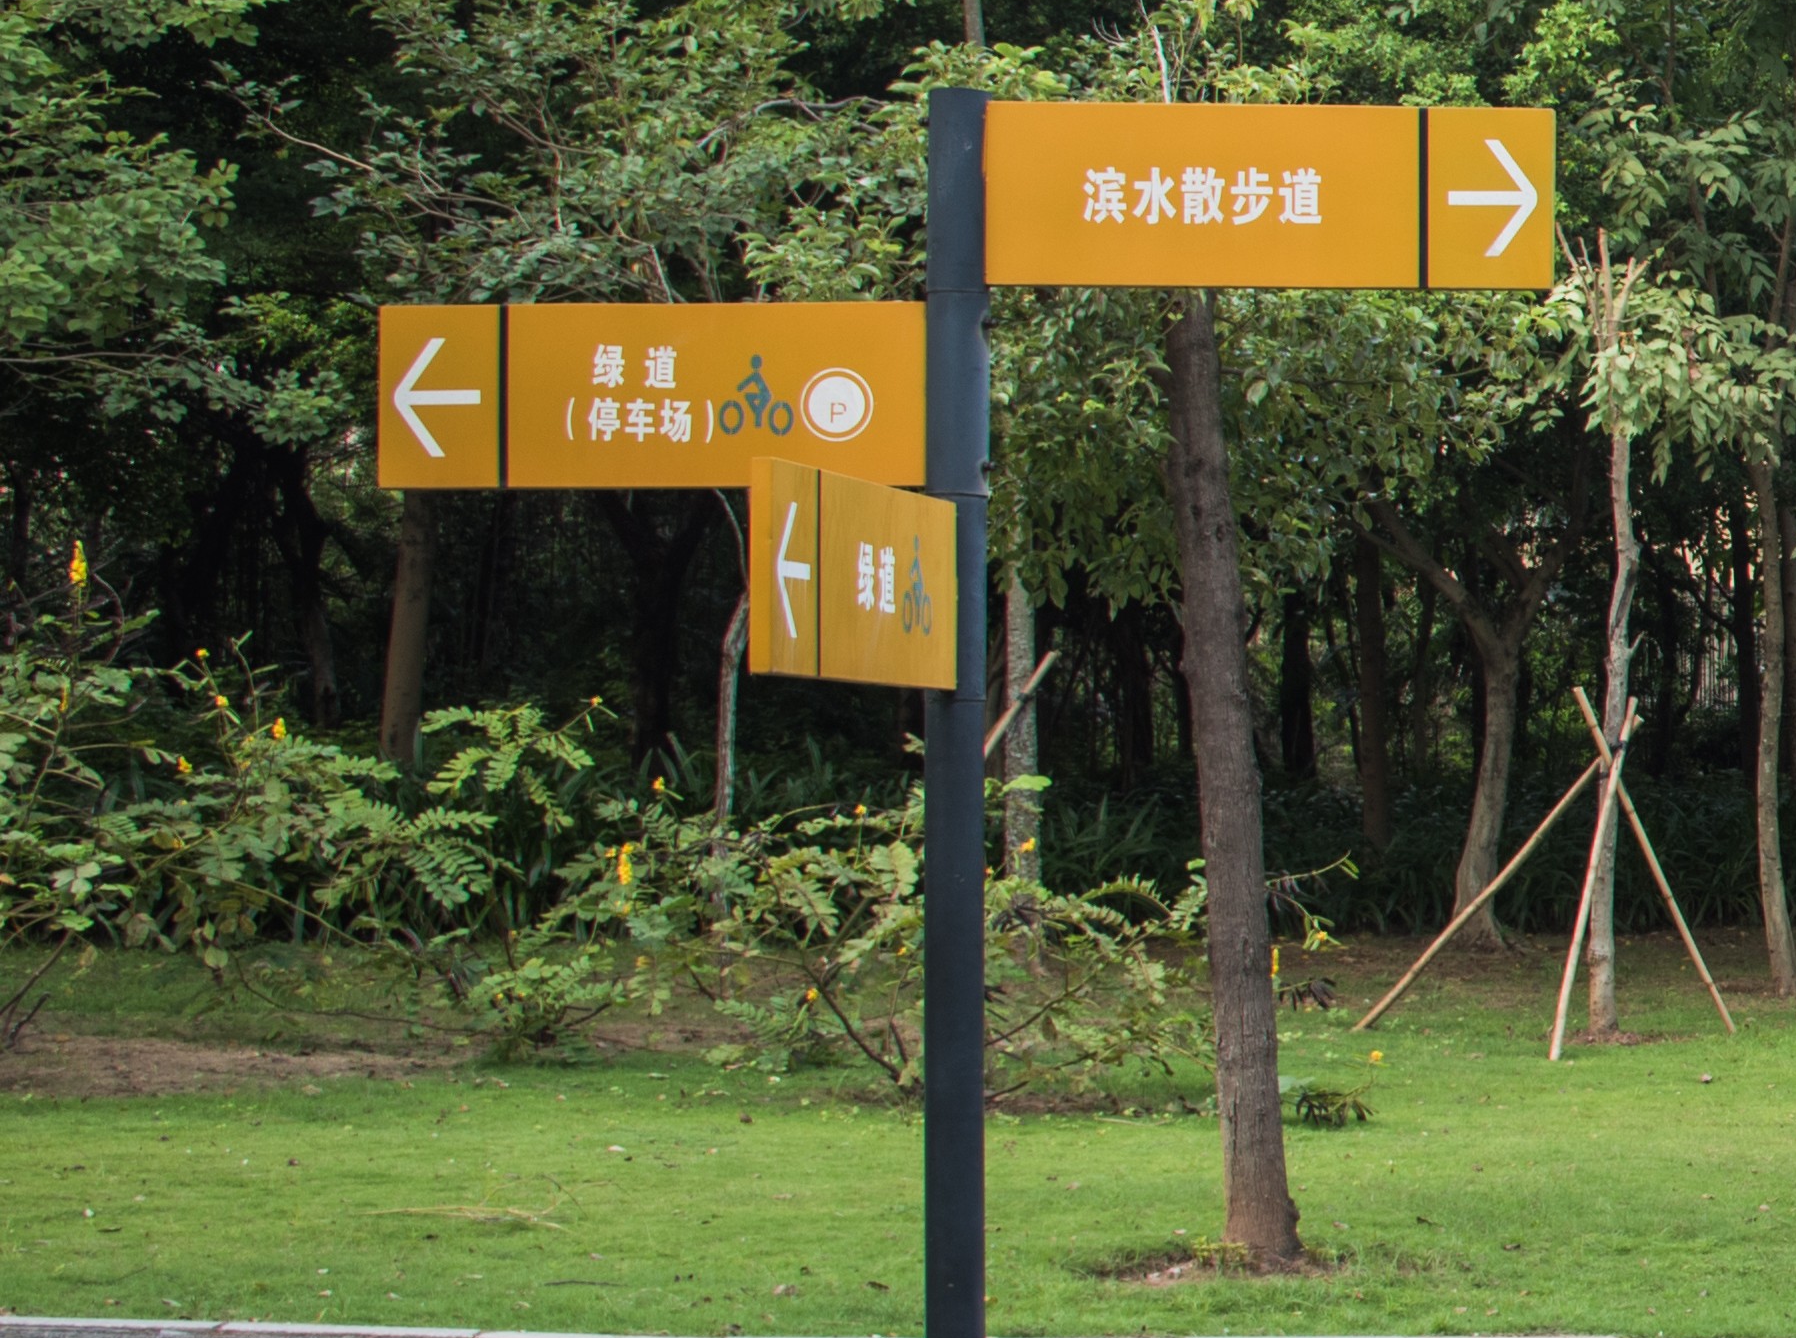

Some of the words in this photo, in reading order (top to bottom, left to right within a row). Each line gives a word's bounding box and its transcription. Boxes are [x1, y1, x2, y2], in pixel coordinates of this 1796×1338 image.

[1082, 166, 1322, 226] 滨水散步道
[592, 344, 677, 389] 绿道
[566, 397, 714, 443] (停车场)
[857, 541, 896, 614] 绿道
